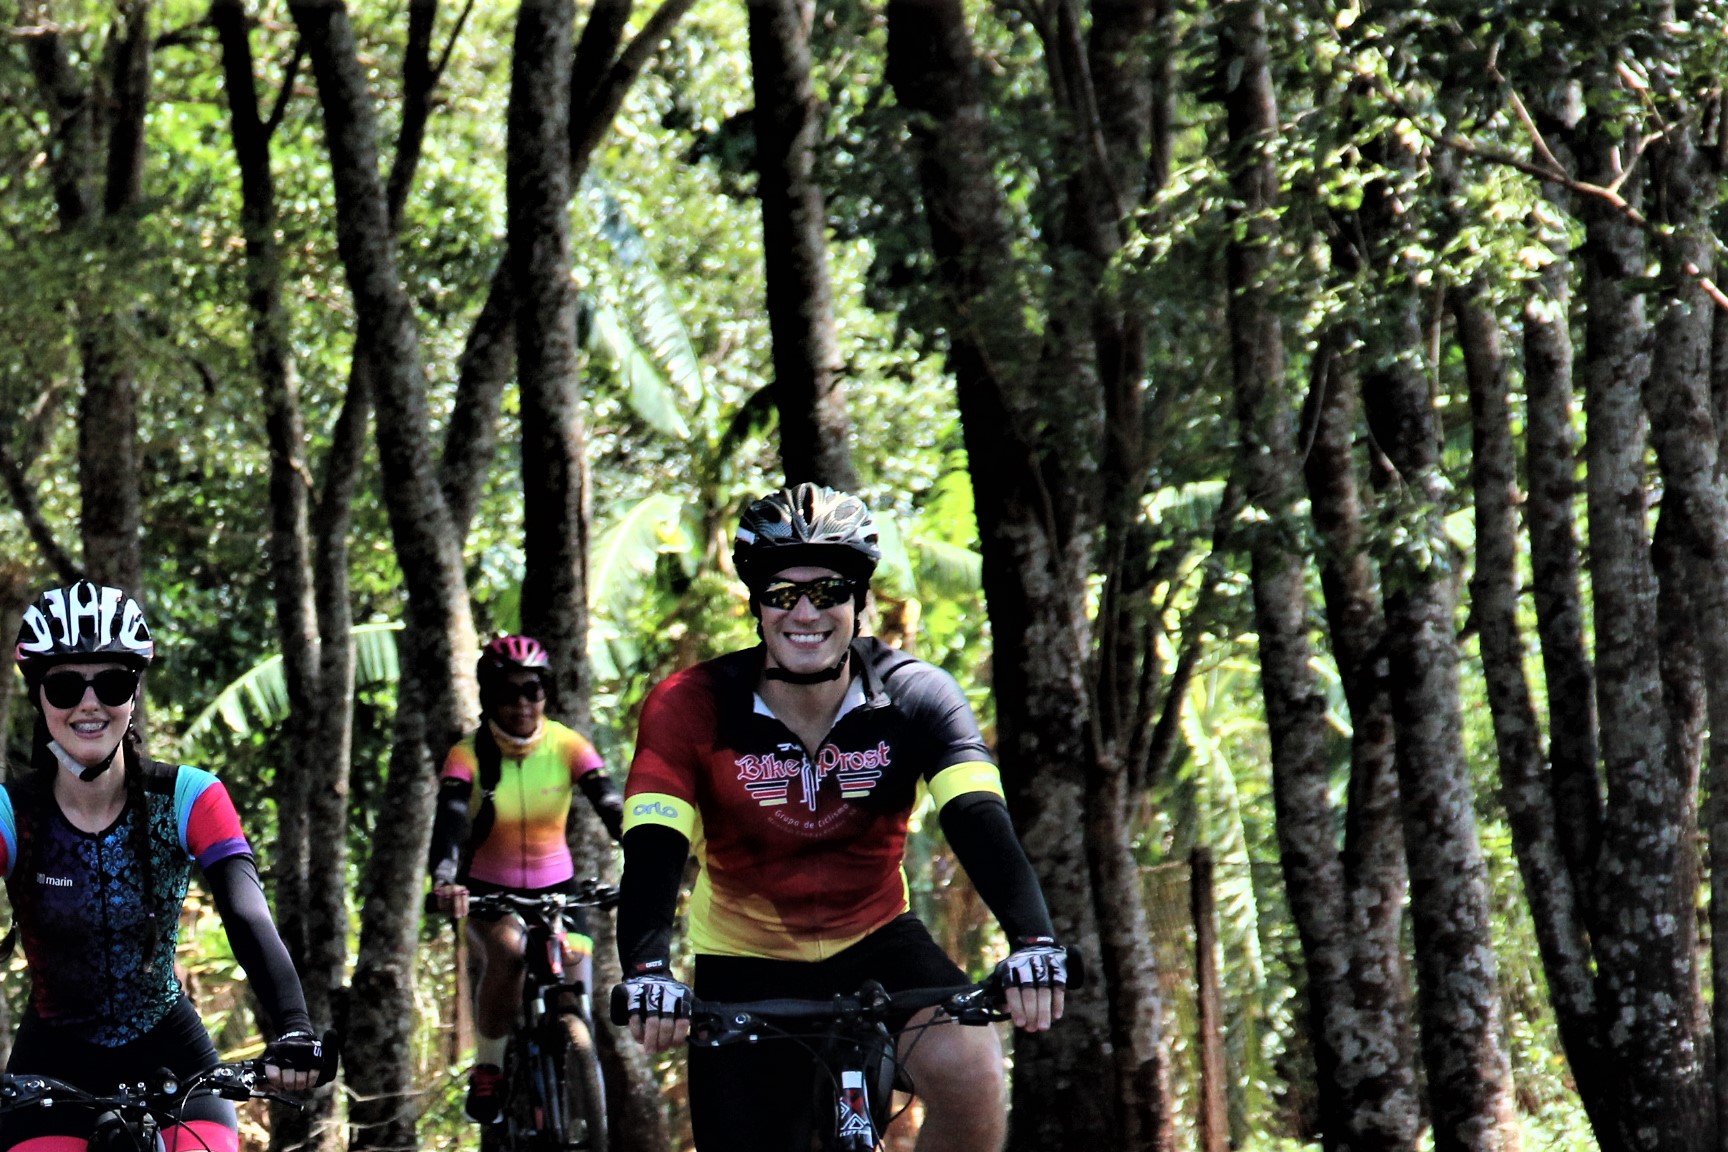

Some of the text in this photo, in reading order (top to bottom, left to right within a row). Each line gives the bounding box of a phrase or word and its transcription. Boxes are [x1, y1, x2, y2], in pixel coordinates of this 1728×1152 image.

[734, 741, 891, 780] Bike Prost
[774, 809, 799, 827] Grupo
